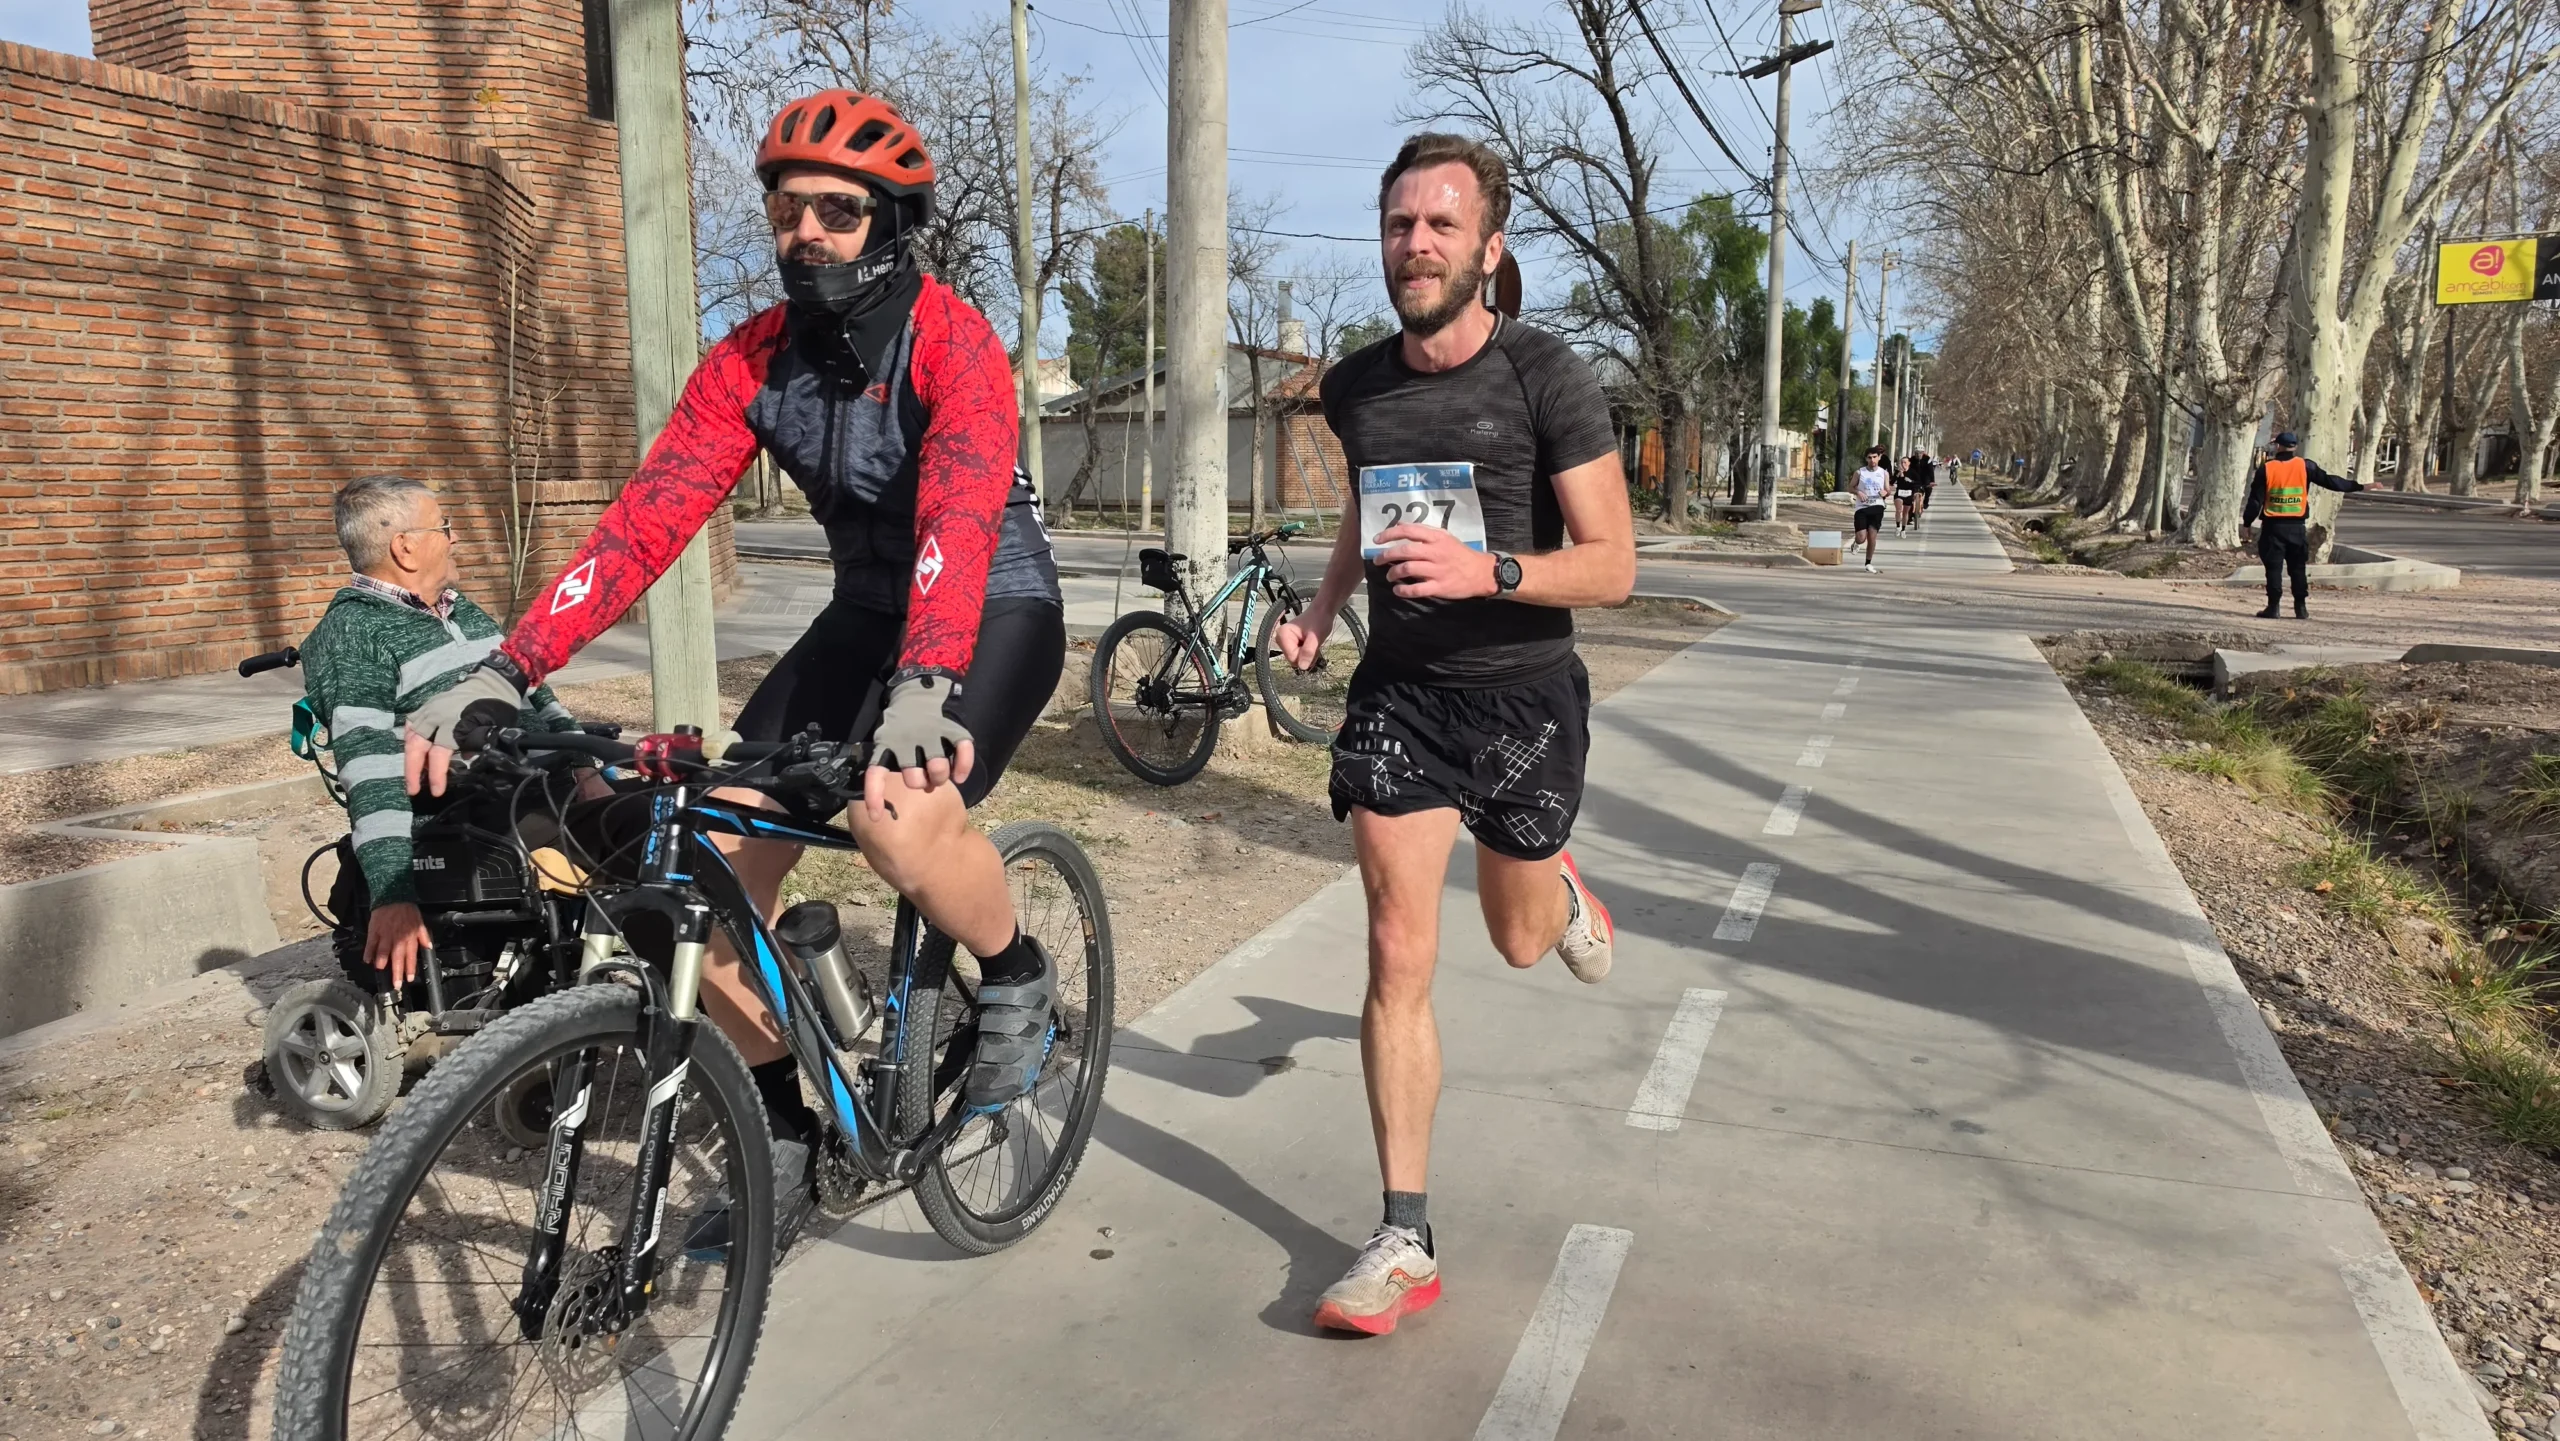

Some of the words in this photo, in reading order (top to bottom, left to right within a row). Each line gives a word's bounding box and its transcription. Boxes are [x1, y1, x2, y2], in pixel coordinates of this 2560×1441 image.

[1397, 472, 1428, 488] 21K
[1381, 500, 1456, 531] 227
[1238, 590, 1258, 659] TOPMEGA
[668, 1083, 685, 1143] RAIDON
[625, 1213, 644, 1280] MARCOS
[638, 1139, 656, 1211] FAJARDO
[1021, 1173, 1067, 1231] CHAOYANG
